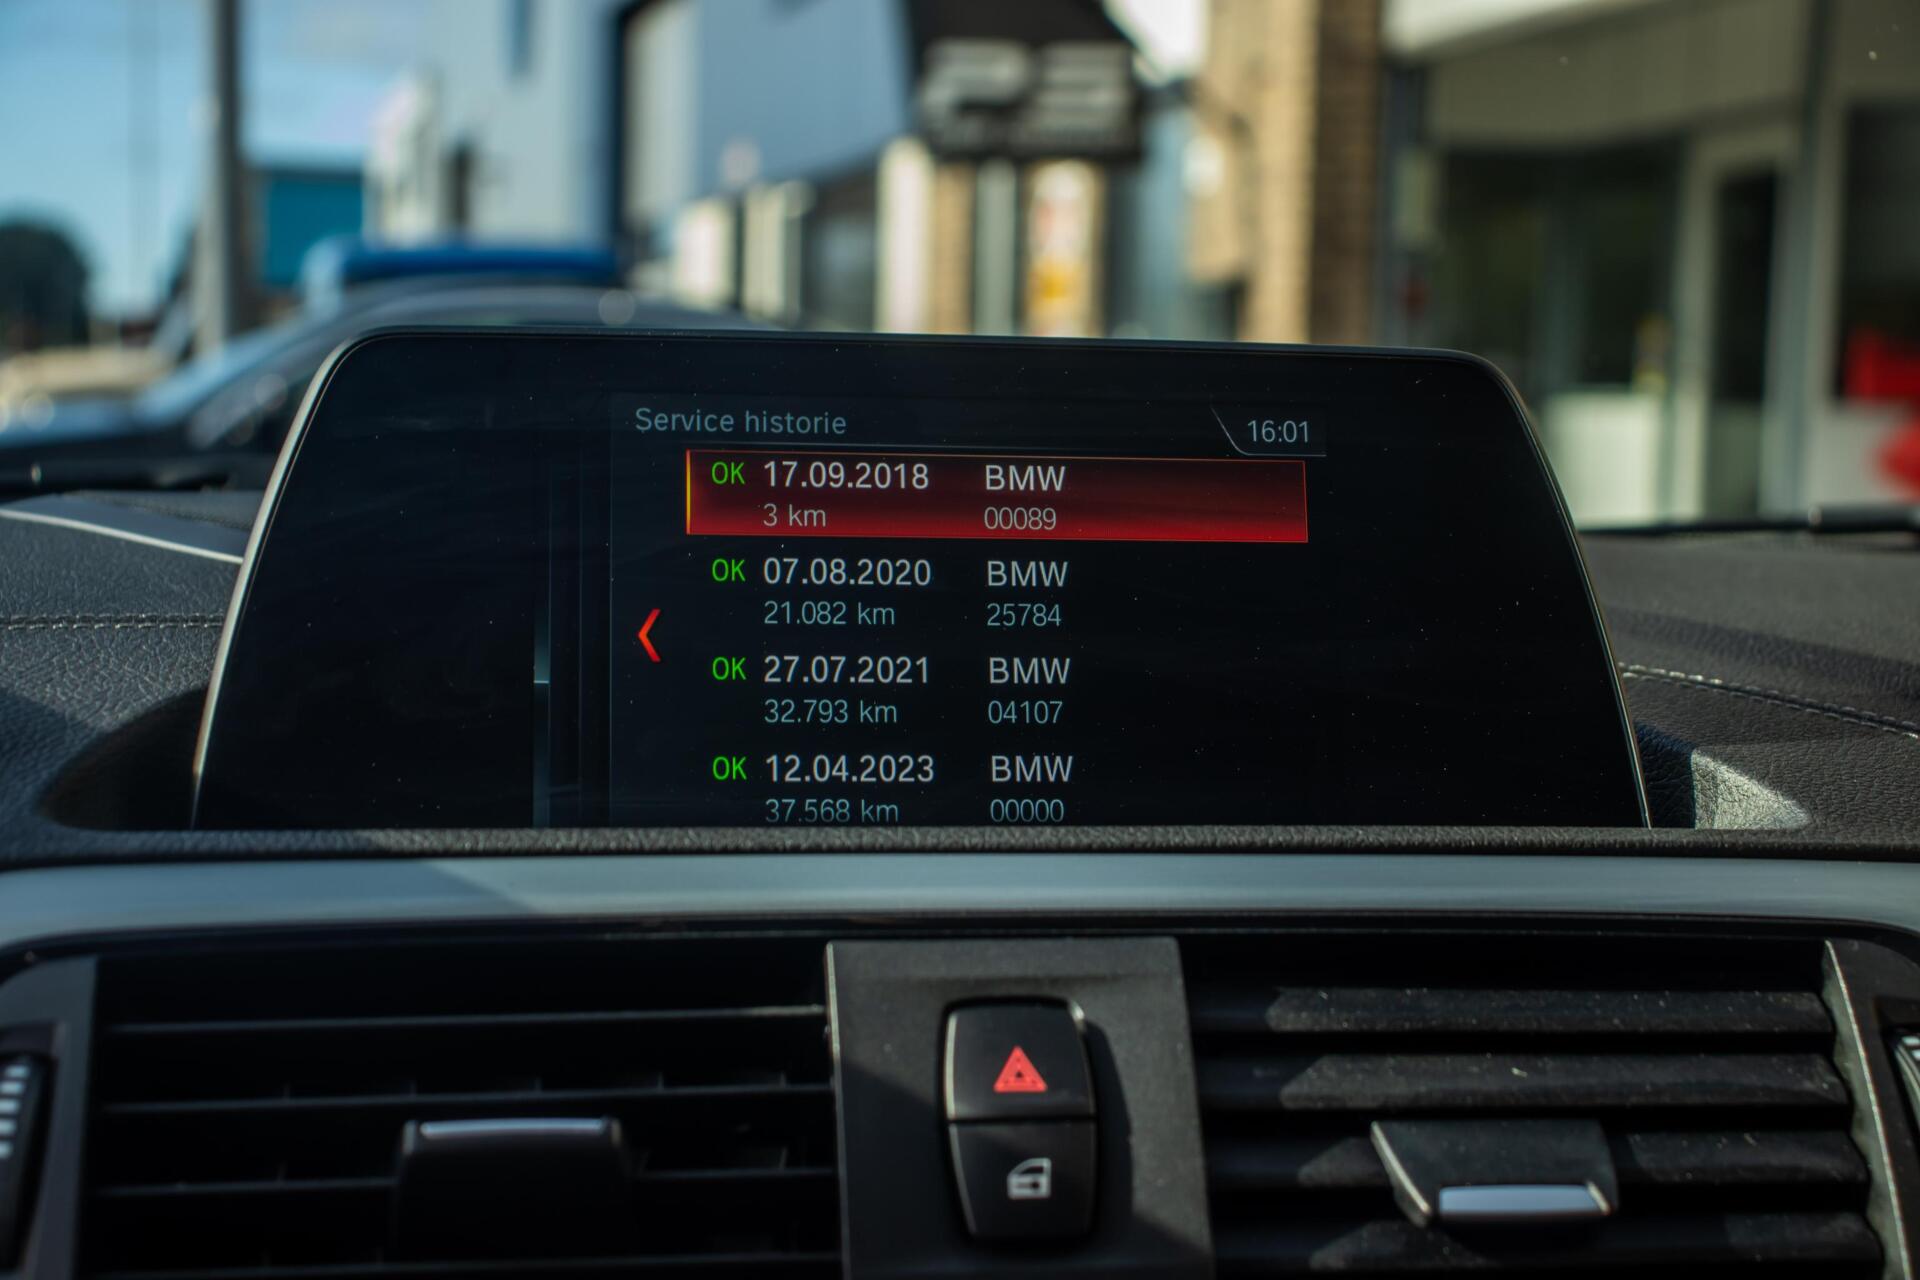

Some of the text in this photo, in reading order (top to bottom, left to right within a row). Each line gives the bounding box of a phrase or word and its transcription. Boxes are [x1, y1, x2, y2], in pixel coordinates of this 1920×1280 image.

[635, 407, 847, 435] Service historie
[1247, 419, 1309, 443] 16:01
[711, 460, 1066, 492] OK 17.09.2018 BMW
[763, 502, 1057, 531] 3 km 00089
[711, 557, 1069, 587] OK 07.08.2020 BMW
[764, 600, 1062, 627] 21.082 km 25784
[712, 654, 1071, 685] OK 27.07.2021 BMW
[764, 698, 1063, 725] 32.793 km 04107
[712, 754, 1073, 783] OK 12.04.2023 BMW
[765, 798, 1065, 822] 37.568 km 00000
